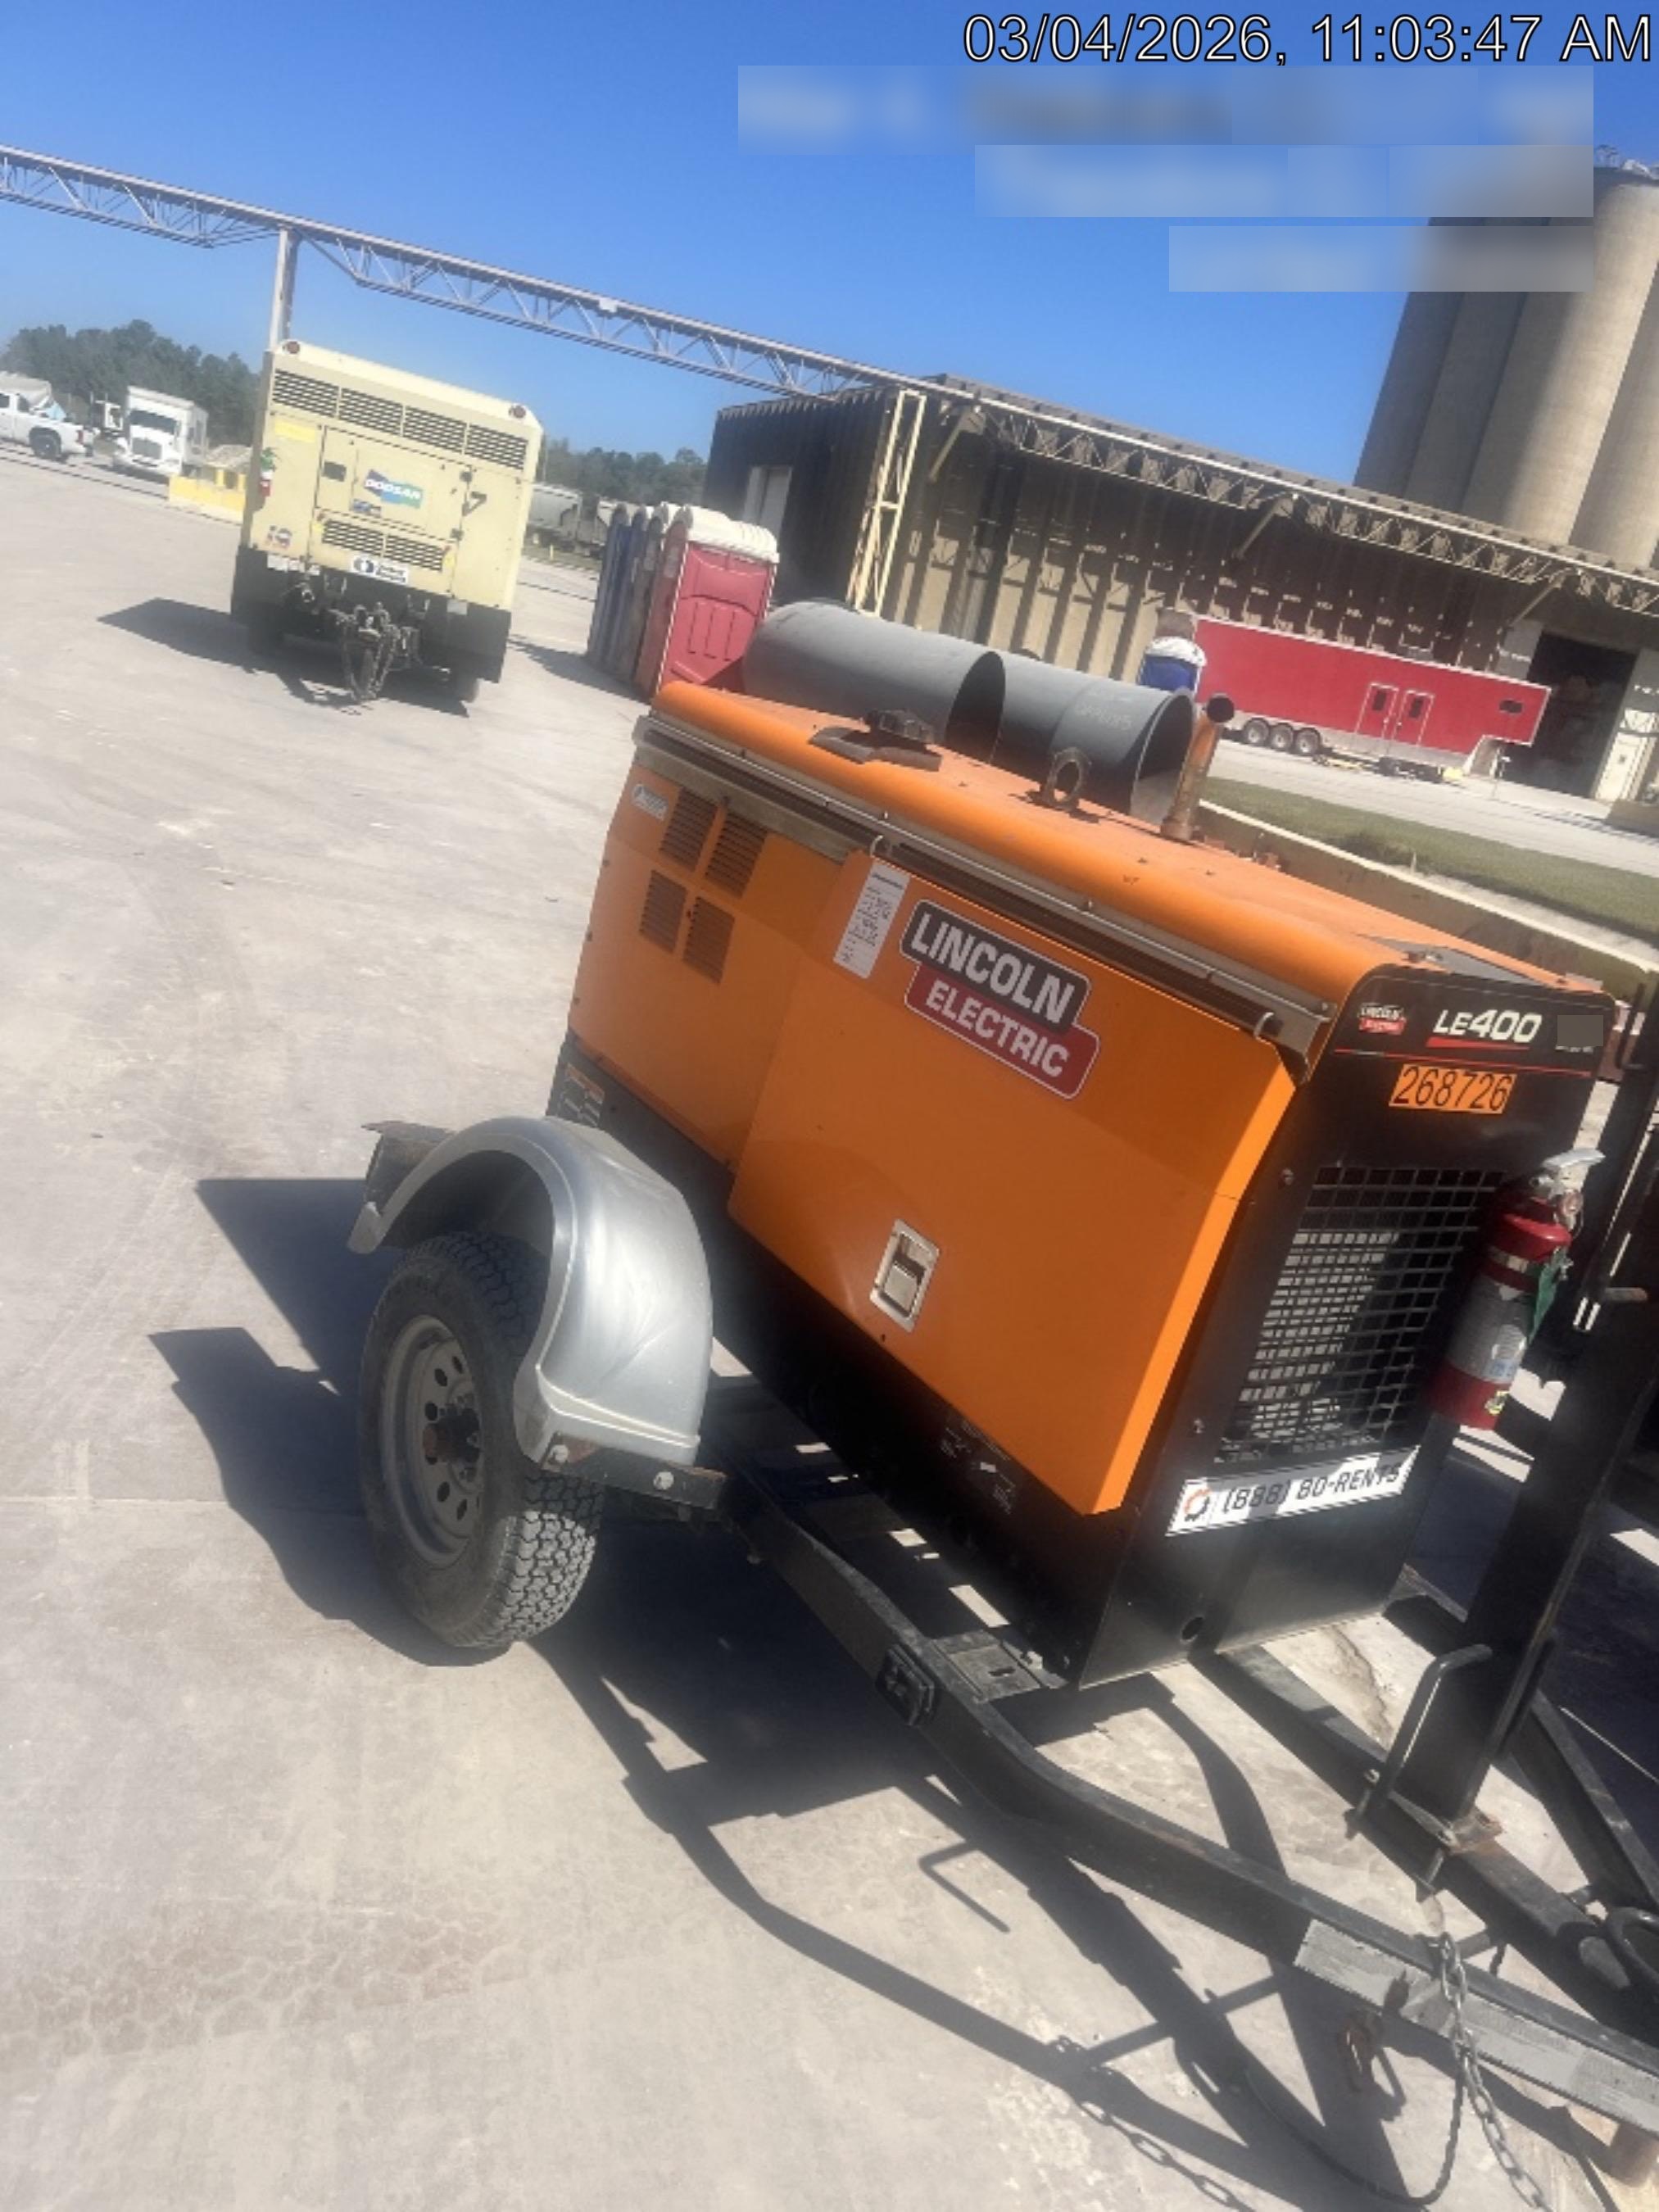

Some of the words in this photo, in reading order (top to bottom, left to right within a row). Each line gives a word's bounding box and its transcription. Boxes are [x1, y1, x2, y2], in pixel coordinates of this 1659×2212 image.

[910, 913, 1075, 1023] LINCOLN
[926, 981, 1069, 1078] ELECTRIC
[1432, 1009, 1543, 1044] LE400
[1393, 1065, 1510, 1112] 268726
[1222, 1479, 1292, 1514] (888)
